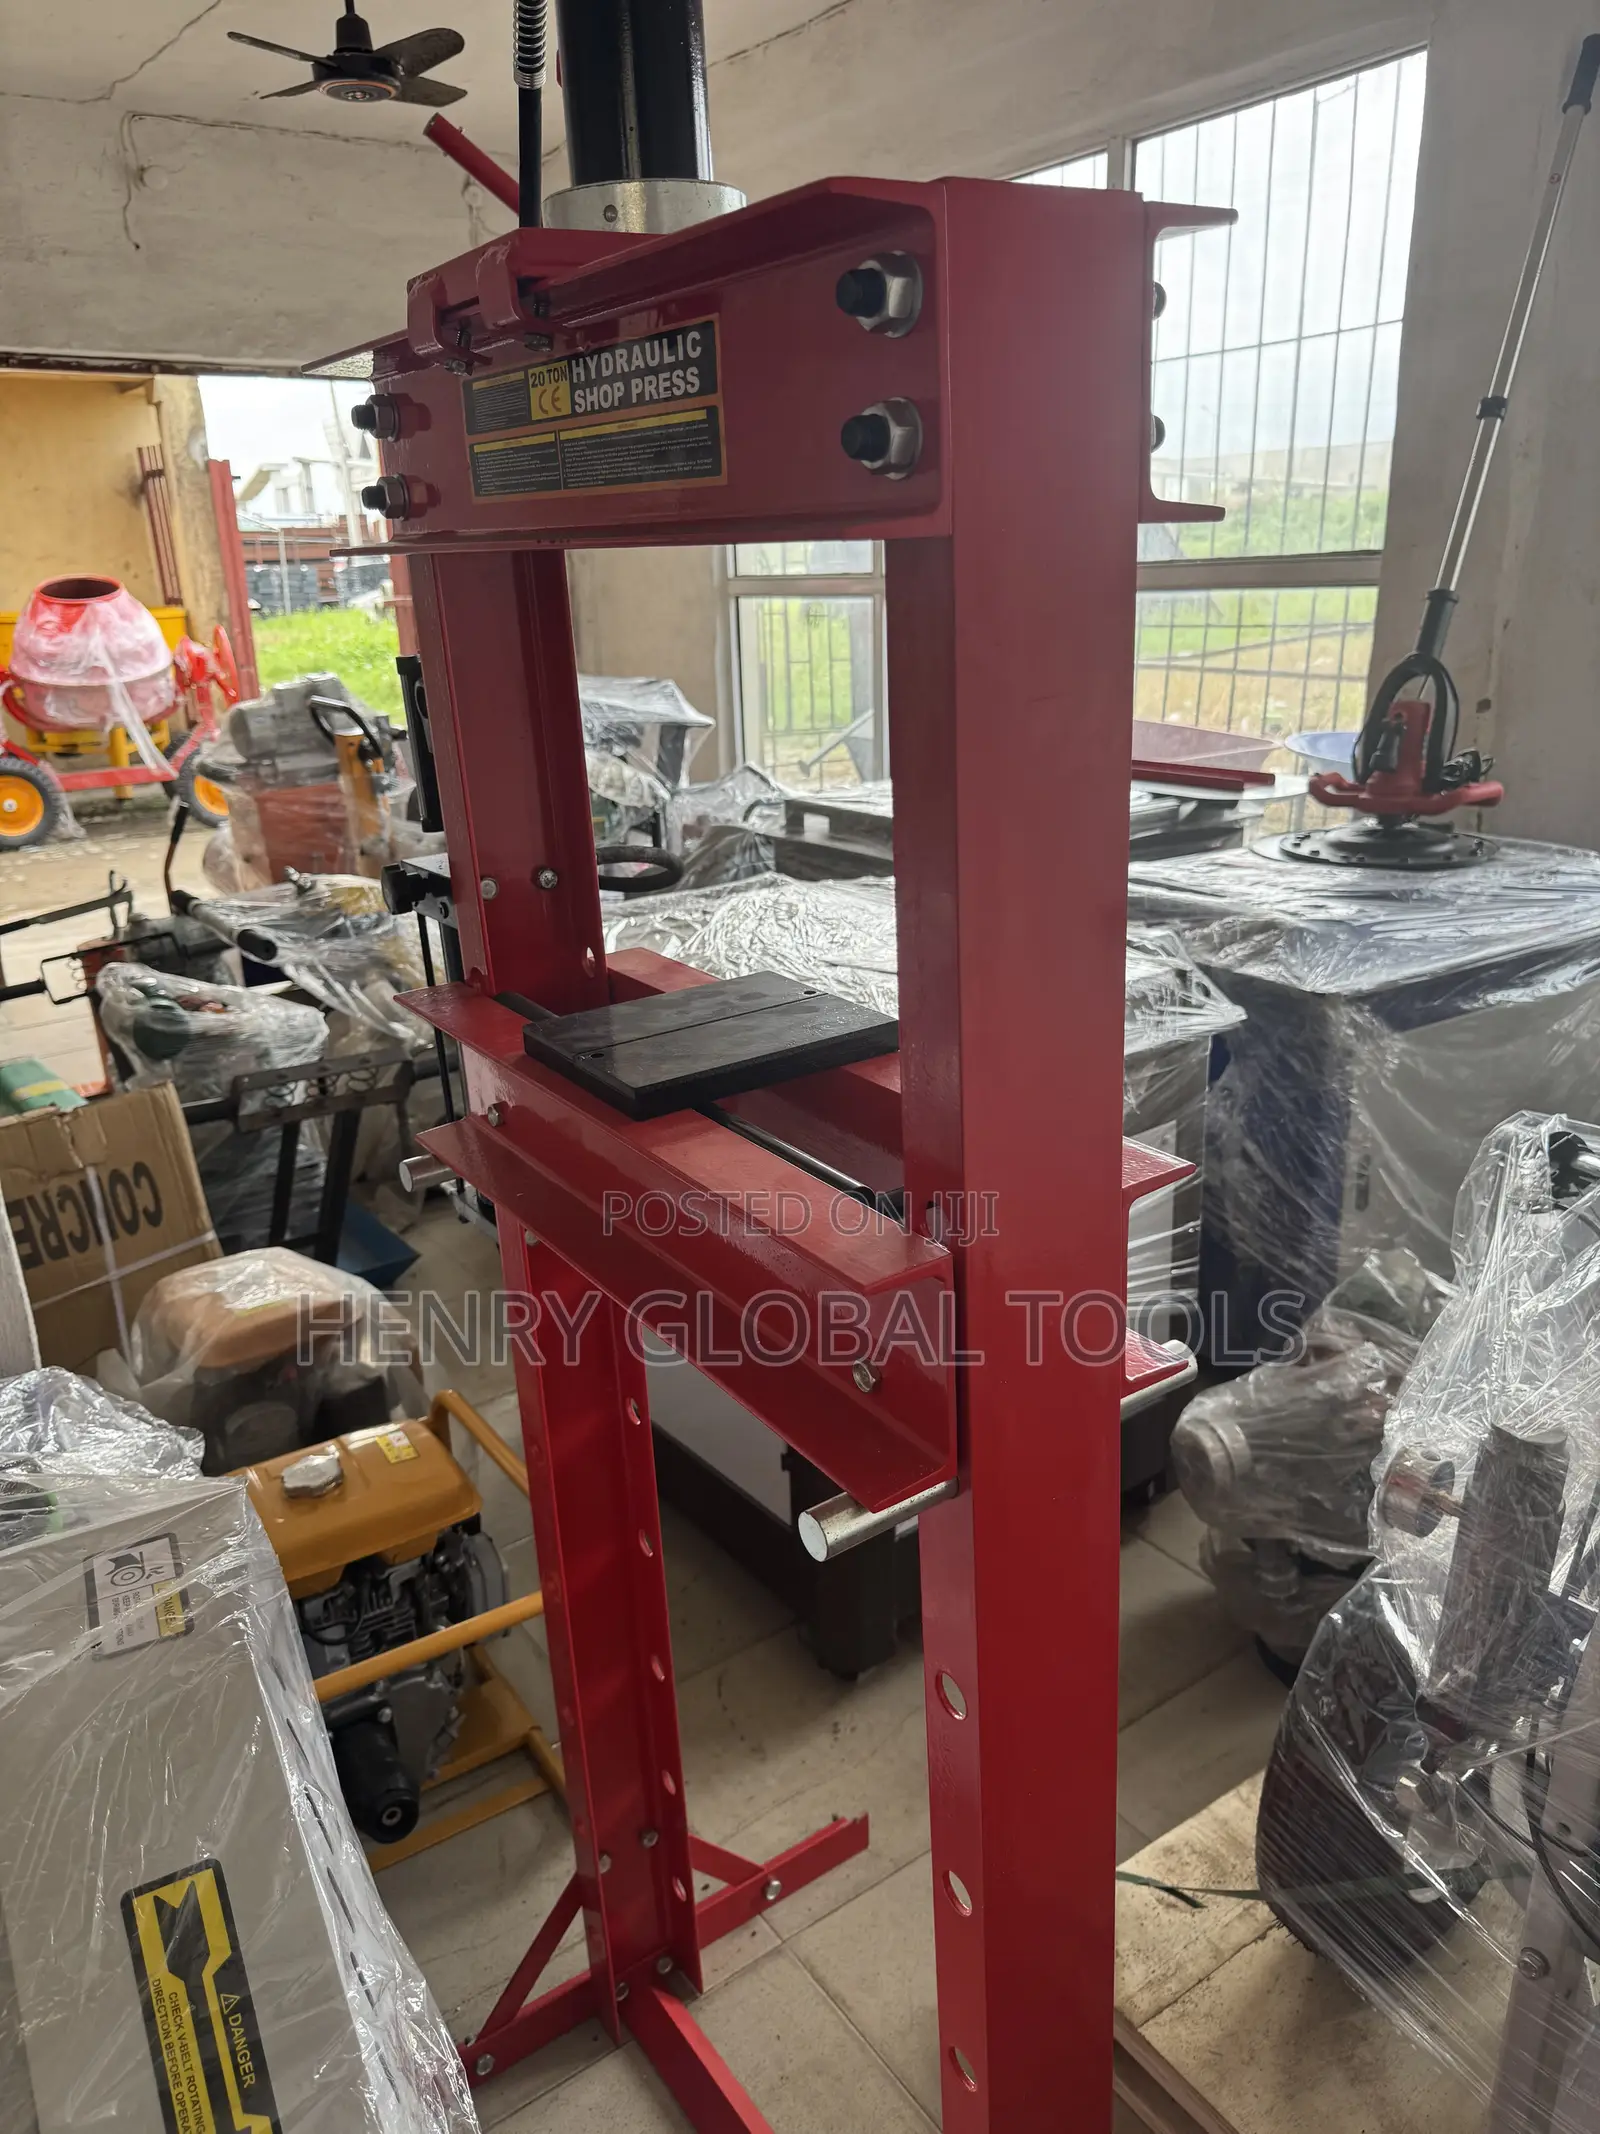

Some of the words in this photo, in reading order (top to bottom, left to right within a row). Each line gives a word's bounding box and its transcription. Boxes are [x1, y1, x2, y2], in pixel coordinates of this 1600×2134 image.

[530, 372, 545, 389] 20
[545, 365, 568, 386] TON
[572, 330, 702, 384] HYDRAULIC
[574, 381, 625, 414] SHOP
[631, 366, 700, 404] PRESS
[151, 1978, 172, 2041] DIRECTION
[164, 2042, 182, 2090] BEFORE
[175, 2091, 192, 2134] OPERA
[168, 1991, 184, 2033] CHECK
[176, 2032, 195, 2074] V-BELT
[228, 2013, 256, 2089] DANGER
